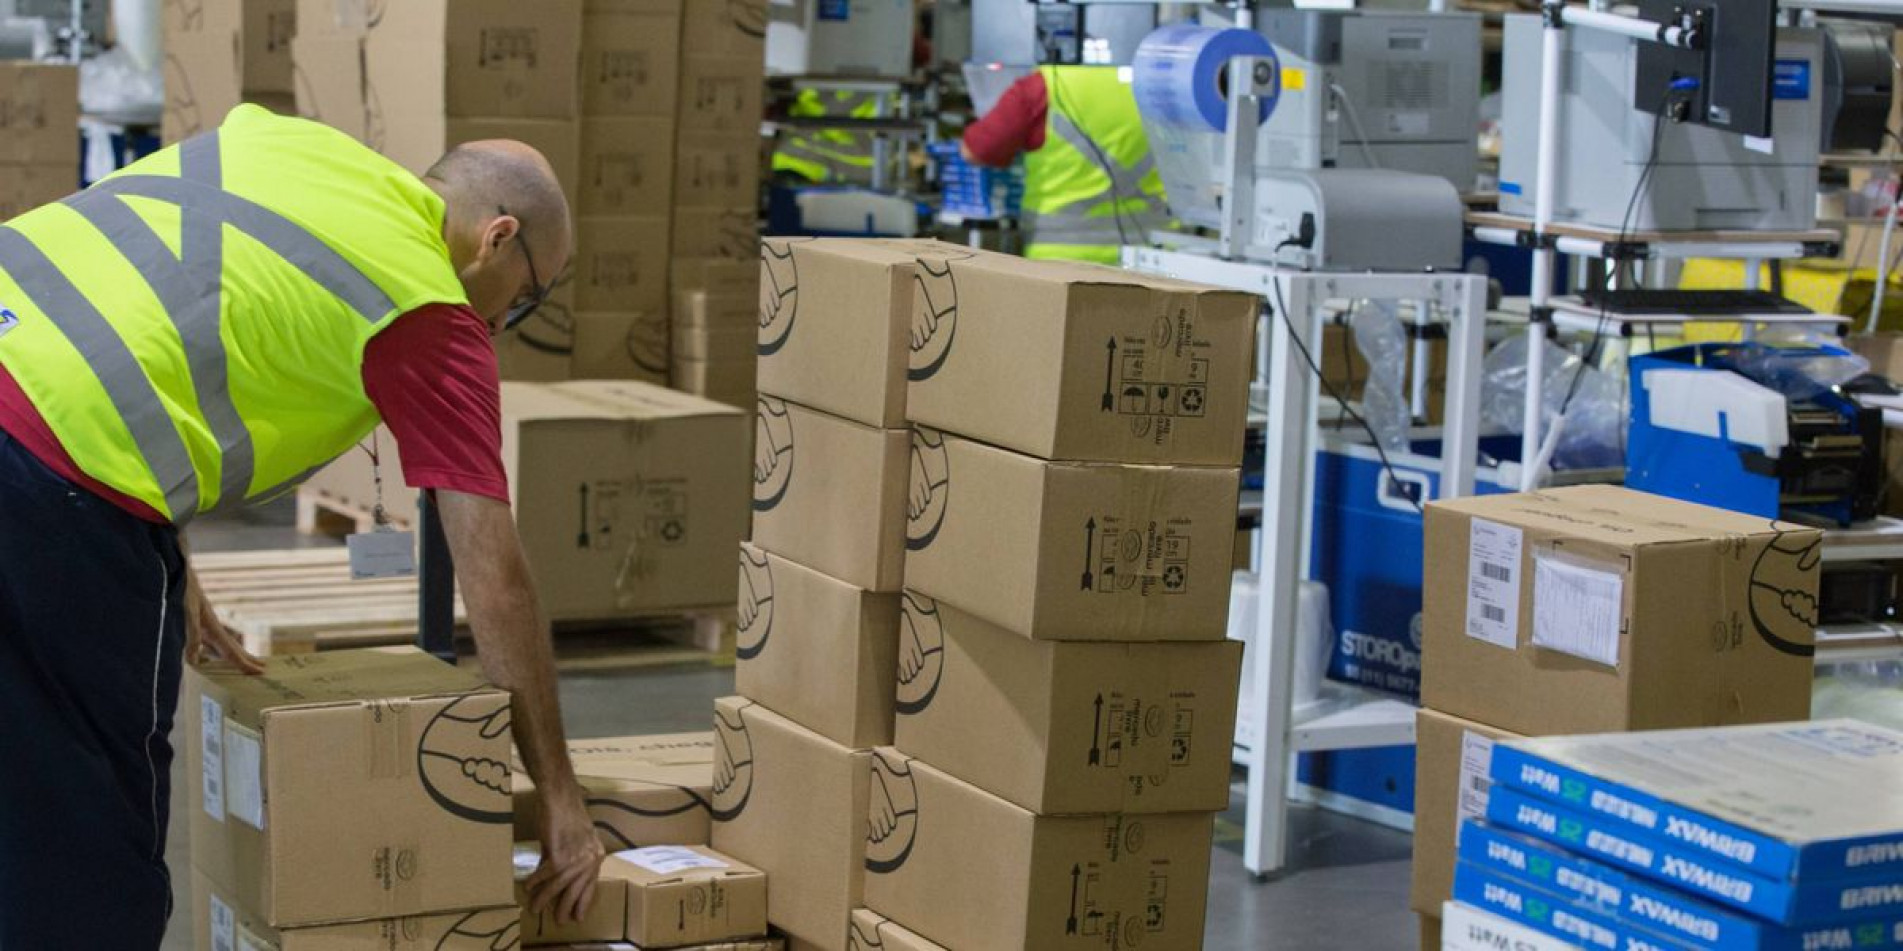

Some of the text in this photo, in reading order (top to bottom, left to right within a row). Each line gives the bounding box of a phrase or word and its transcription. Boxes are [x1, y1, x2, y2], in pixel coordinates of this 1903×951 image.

[1521, 764, 1560, 795] Watt
[1517, 803, 1556, 834] Watt
[1488, 839, 1526, 870] Watt
[1484, 882, 1523, 913] Watt
